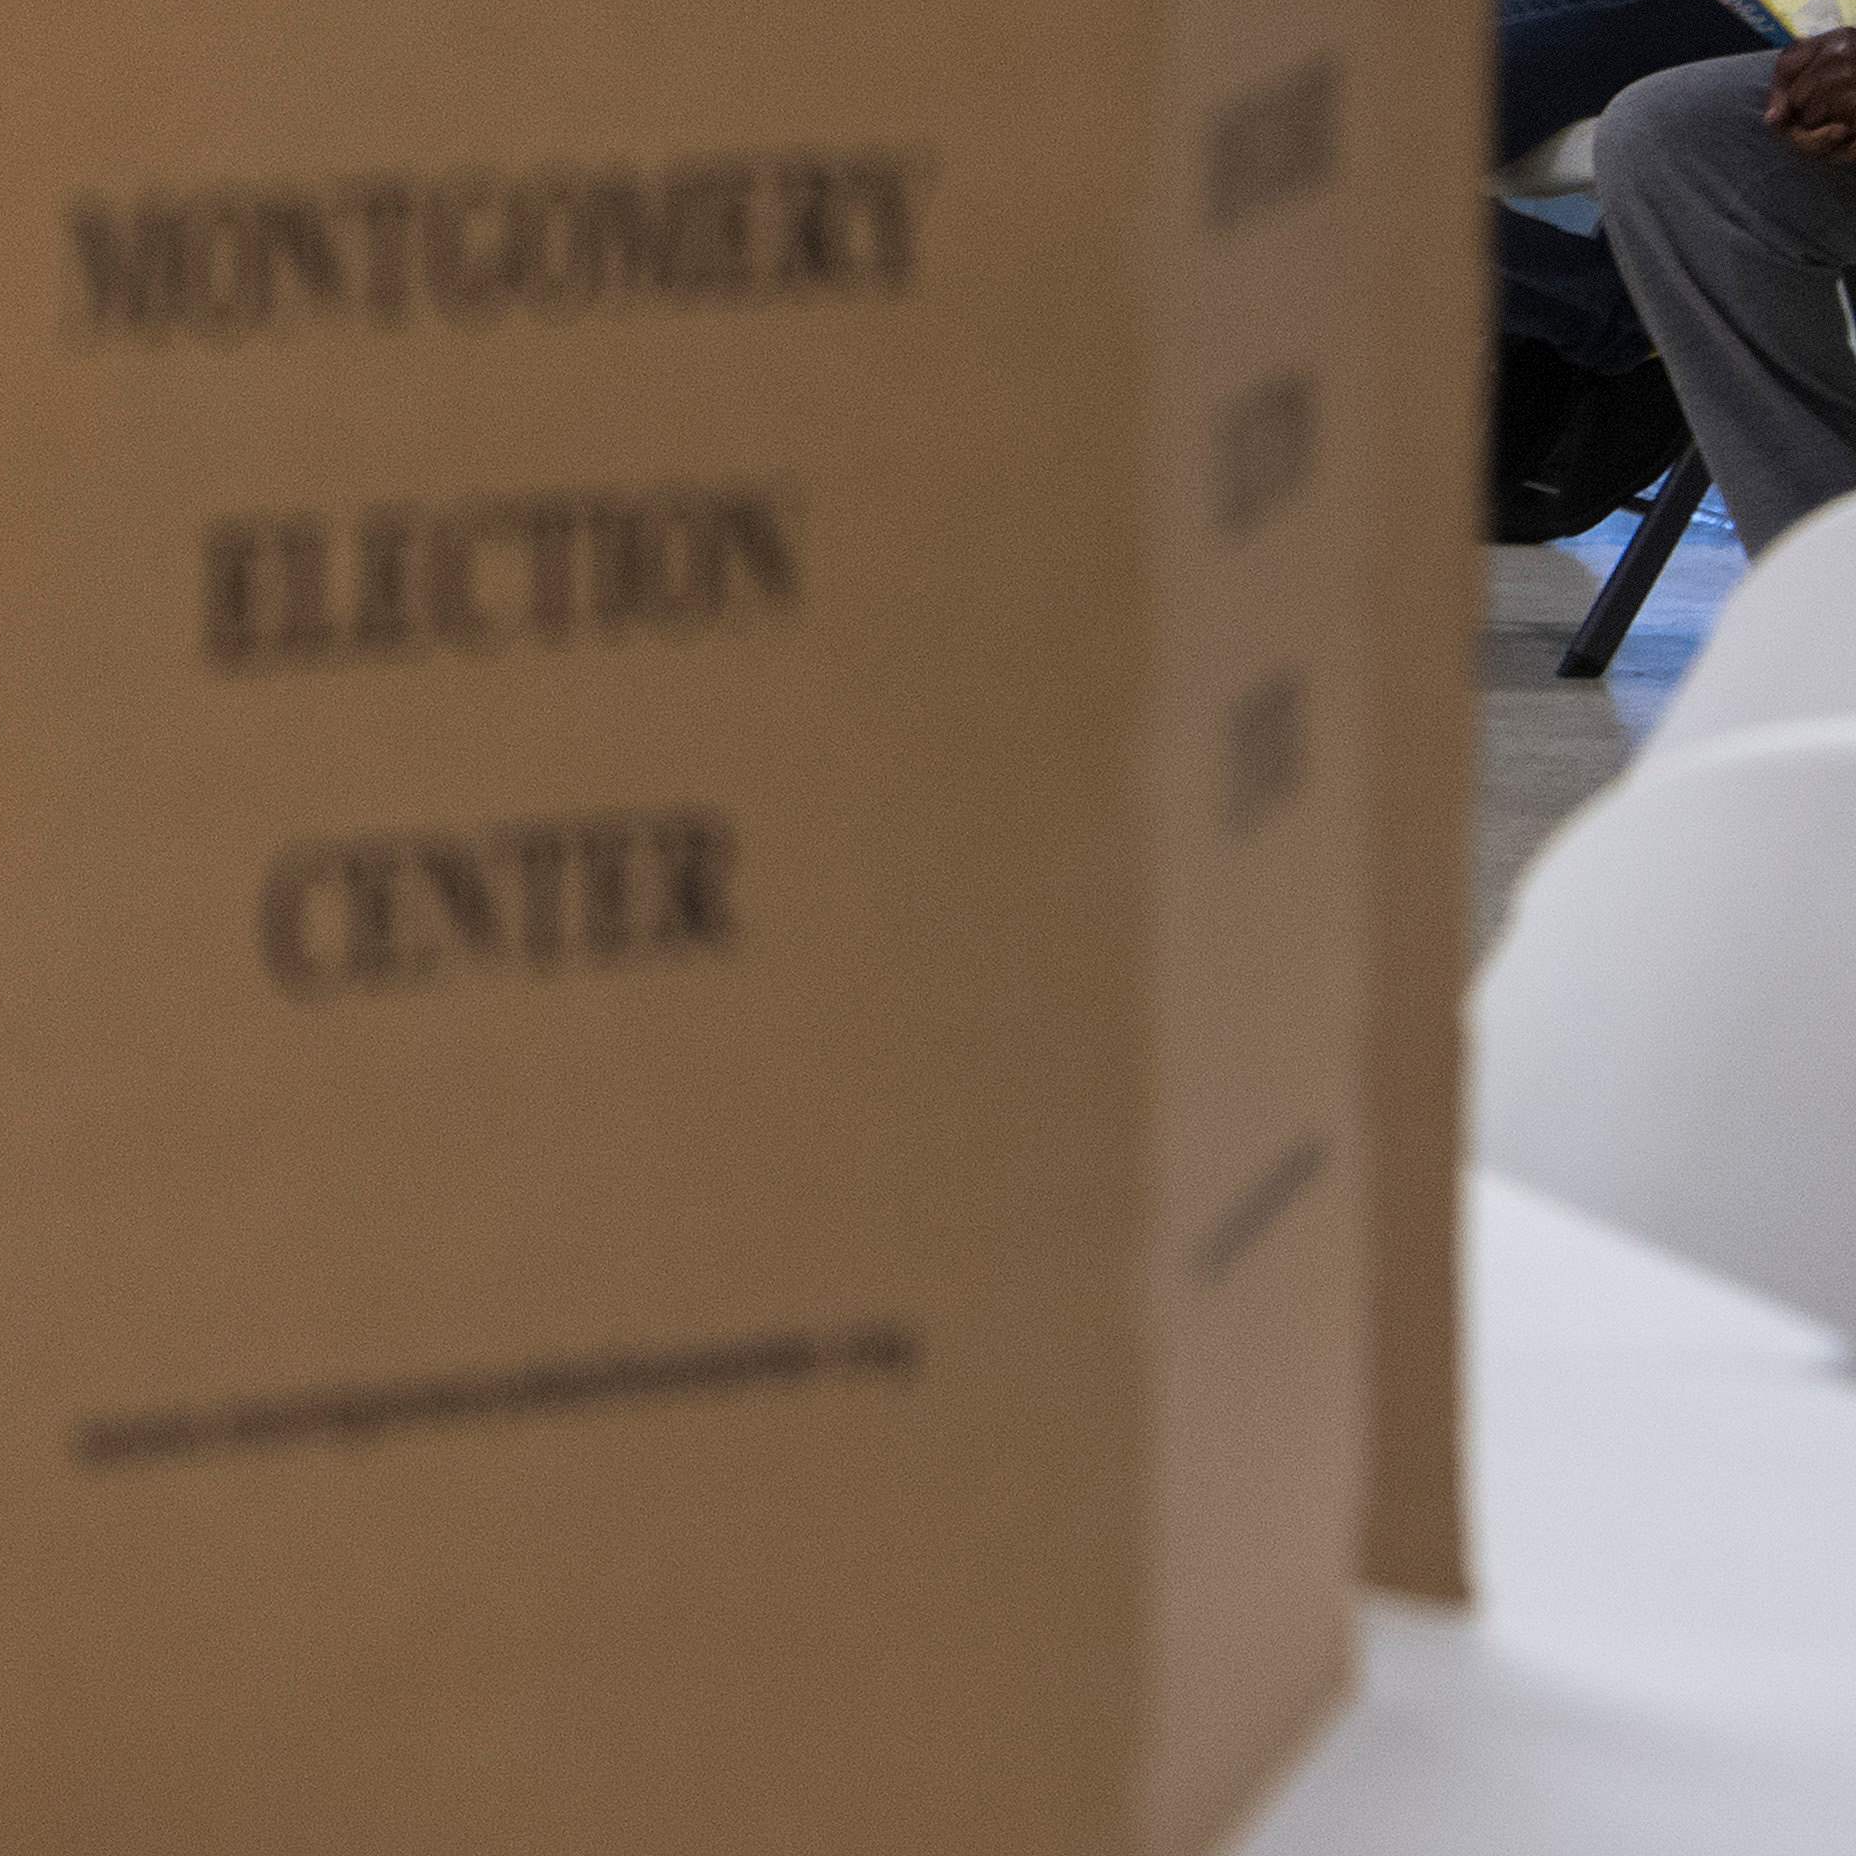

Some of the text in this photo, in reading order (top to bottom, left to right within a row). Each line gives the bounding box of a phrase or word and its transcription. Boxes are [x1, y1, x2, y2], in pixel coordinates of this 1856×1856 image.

[60, 148, 934, 344] MONTGOMERY
[200, 482, 802, 674] ELECTION
[259, 802, 742, 1002] CENTER
